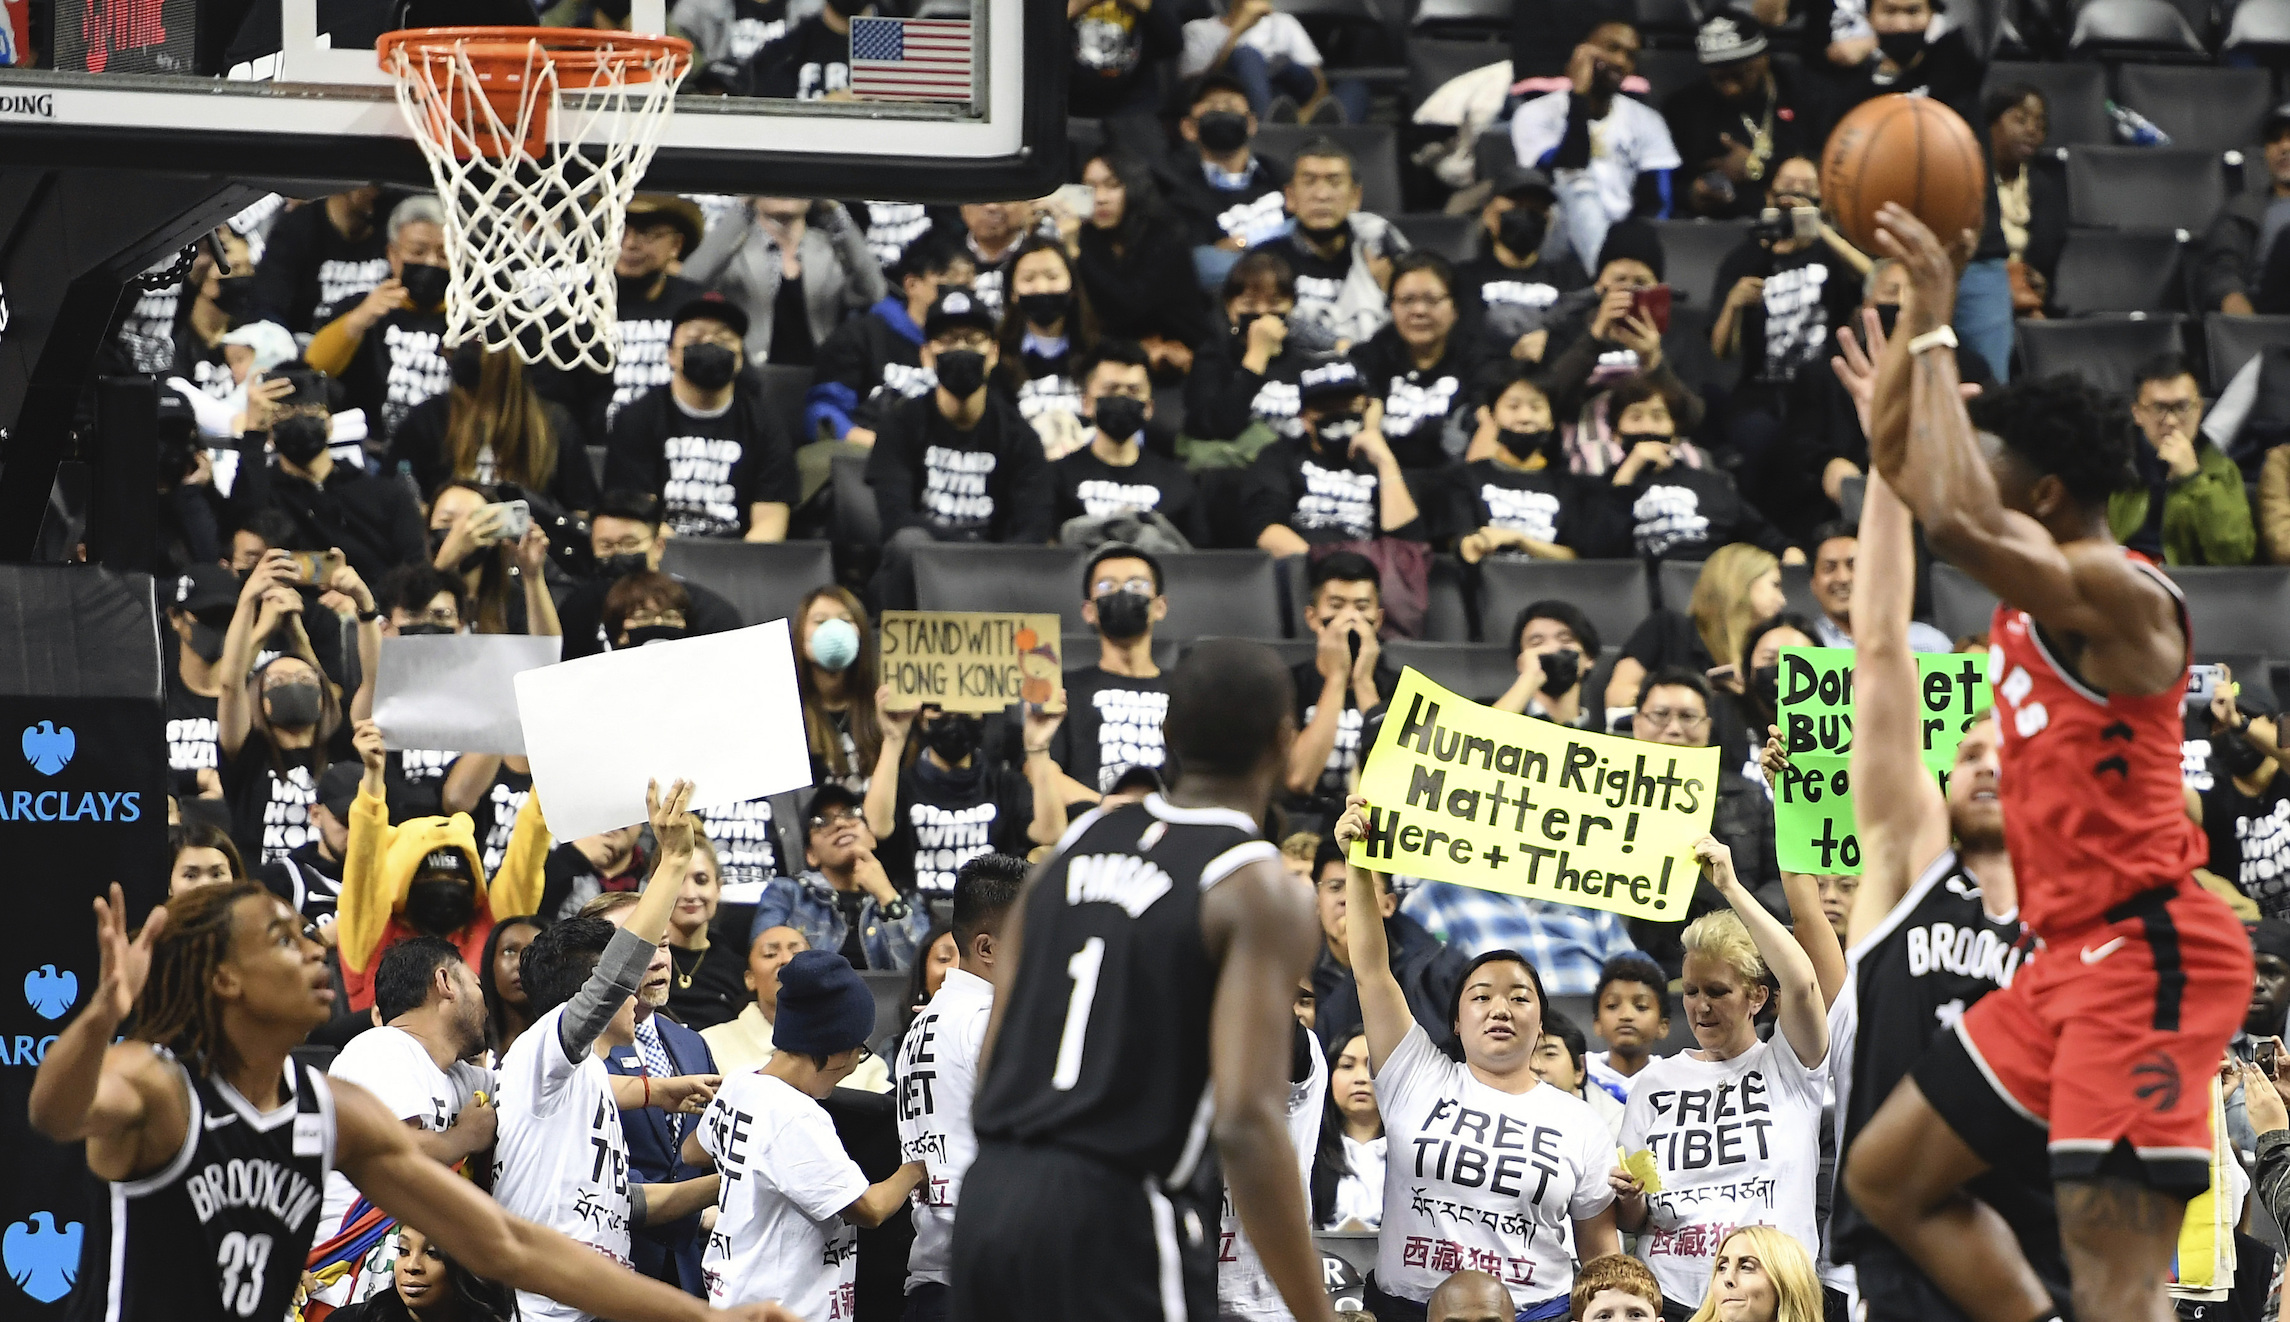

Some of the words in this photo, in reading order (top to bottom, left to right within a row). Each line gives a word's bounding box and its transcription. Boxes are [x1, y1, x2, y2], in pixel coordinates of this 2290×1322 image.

[664, 436, 742, 463] STAND
[924, 445, 996, 473] STAND
[883, 618, 962, 655] STAND
[884, 661, 947, 696] HONG
[957, 662, 1023, 698] KONG
[1397, 692, 1549, 783] Human
[1559, 741, 1705, 815] Rights
[909, 803, 997, 827] STAND
[915, 821, 989, 848] WITH
[1406, 763, 1640, 854] Matter!
[1366, 805, 1473, 865] Here
[1519, 842, 1675, 910] There!
[1052, 936, 1106, 1091] 1
[1649, 1070, 1770, 1127] FREE
[1420, 1096, 1564, 1165] FREE
[1646, 1118, 1773, 1172] TIBET
[186, 1157, 322, 1234] BROOKLYN
[1412, 1137, 1559, 1206] TIBET
[1403, 1235, 1538, 1287] 西藏独立
[1649, 1219, 1777, 1258] 西藏
[216, 1230, 274, 1318] 33
